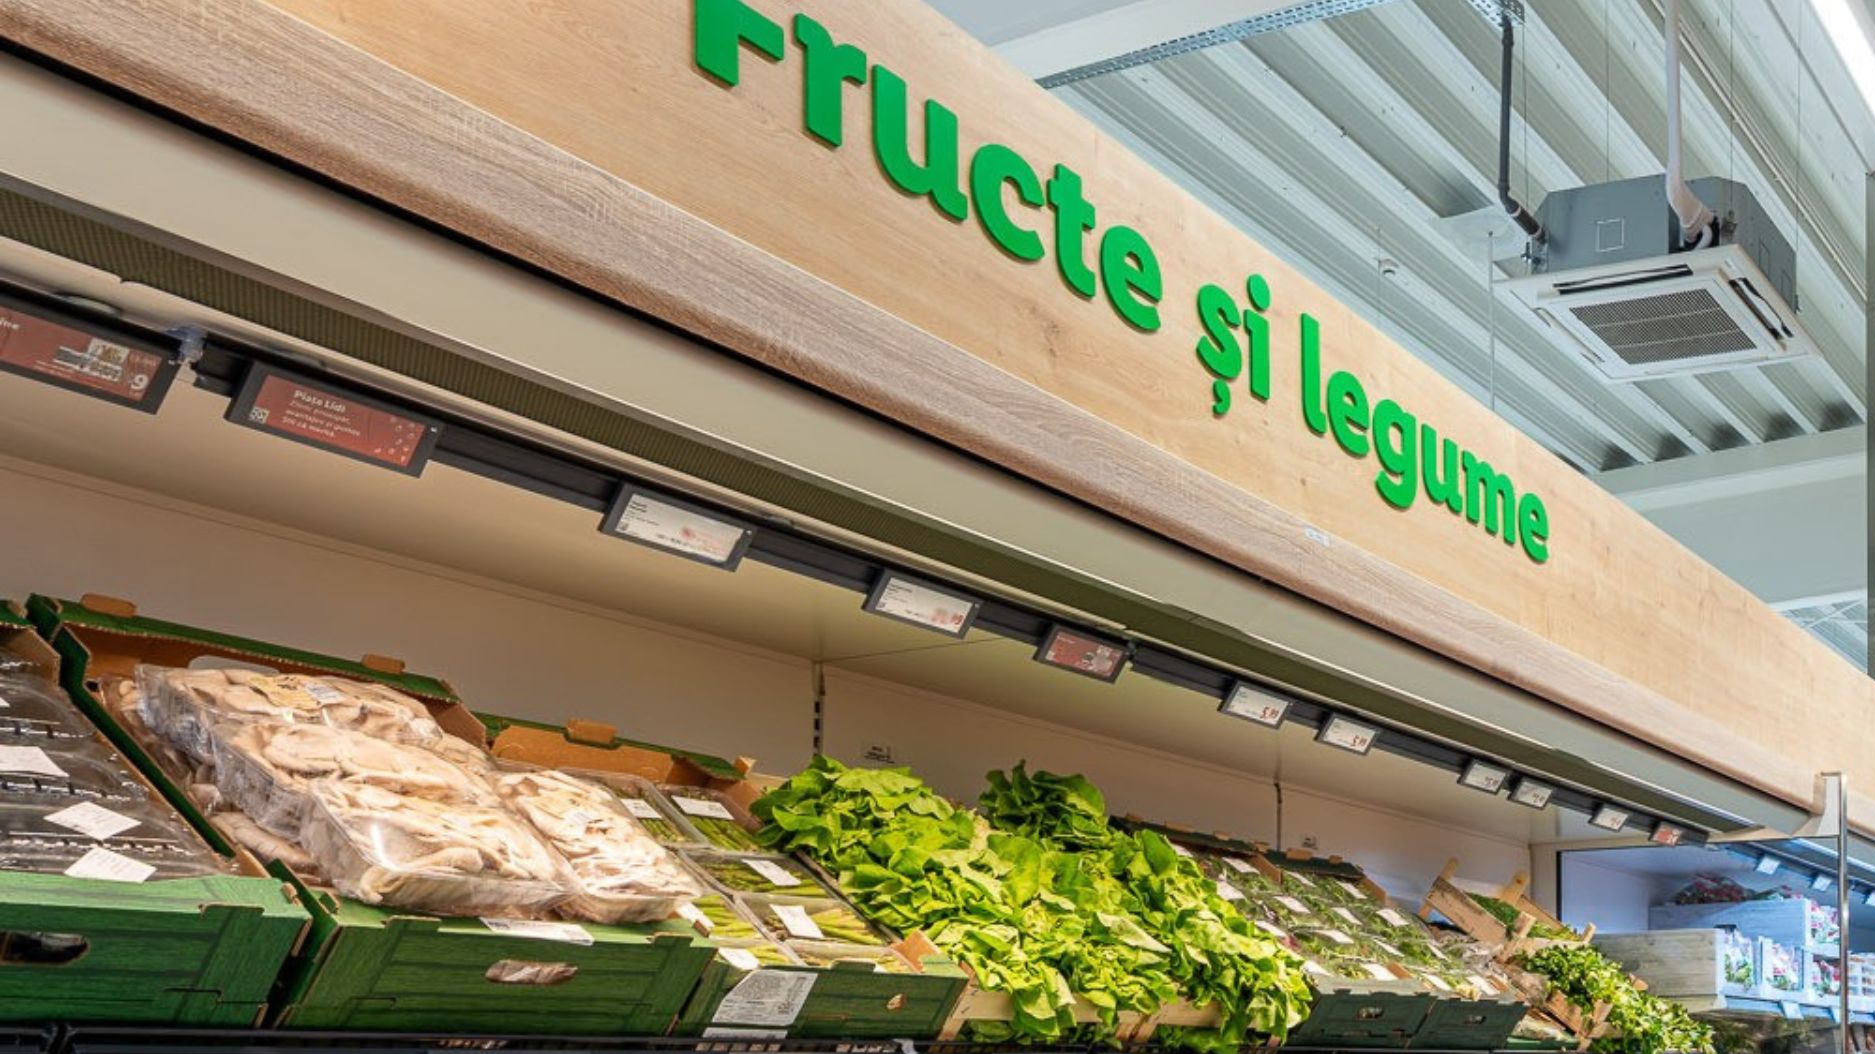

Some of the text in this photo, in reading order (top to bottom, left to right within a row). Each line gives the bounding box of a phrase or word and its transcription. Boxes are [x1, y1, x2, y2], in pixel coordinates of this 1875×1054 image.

[324, 399, 347, 413] Lidl
[1196, 275, 1271, 415] și
[1300, 313, 1549, 563] legume
